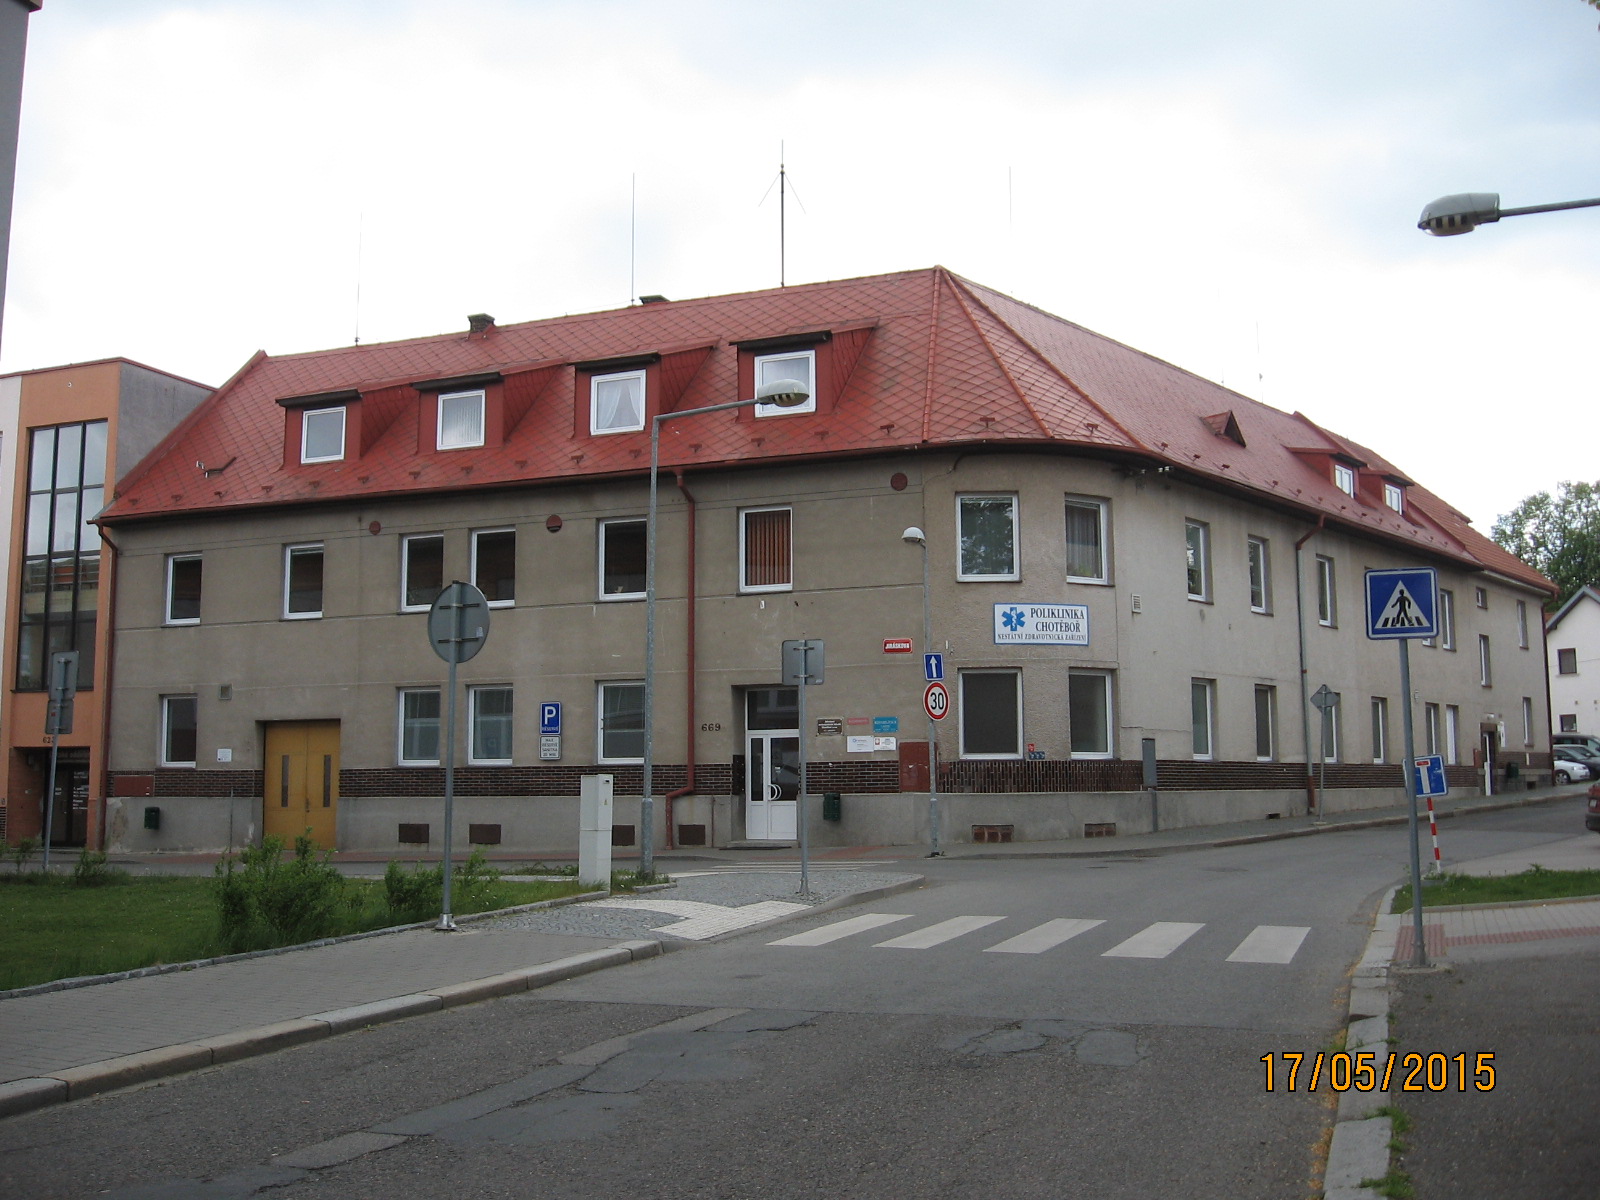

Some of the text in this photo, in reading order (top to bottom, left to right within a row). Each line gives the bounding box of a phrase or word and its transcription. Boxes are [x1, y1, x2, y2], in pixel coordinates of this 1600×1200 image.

[1030, 607, 1085, 620] POLIKLINIKA
[1035, 620, 1081, 633] CHOTĚBOŘ
[930, 692, 945, 710] 30
[544, 706, 557, 725] P
[701, 722, 721, 732] 669
